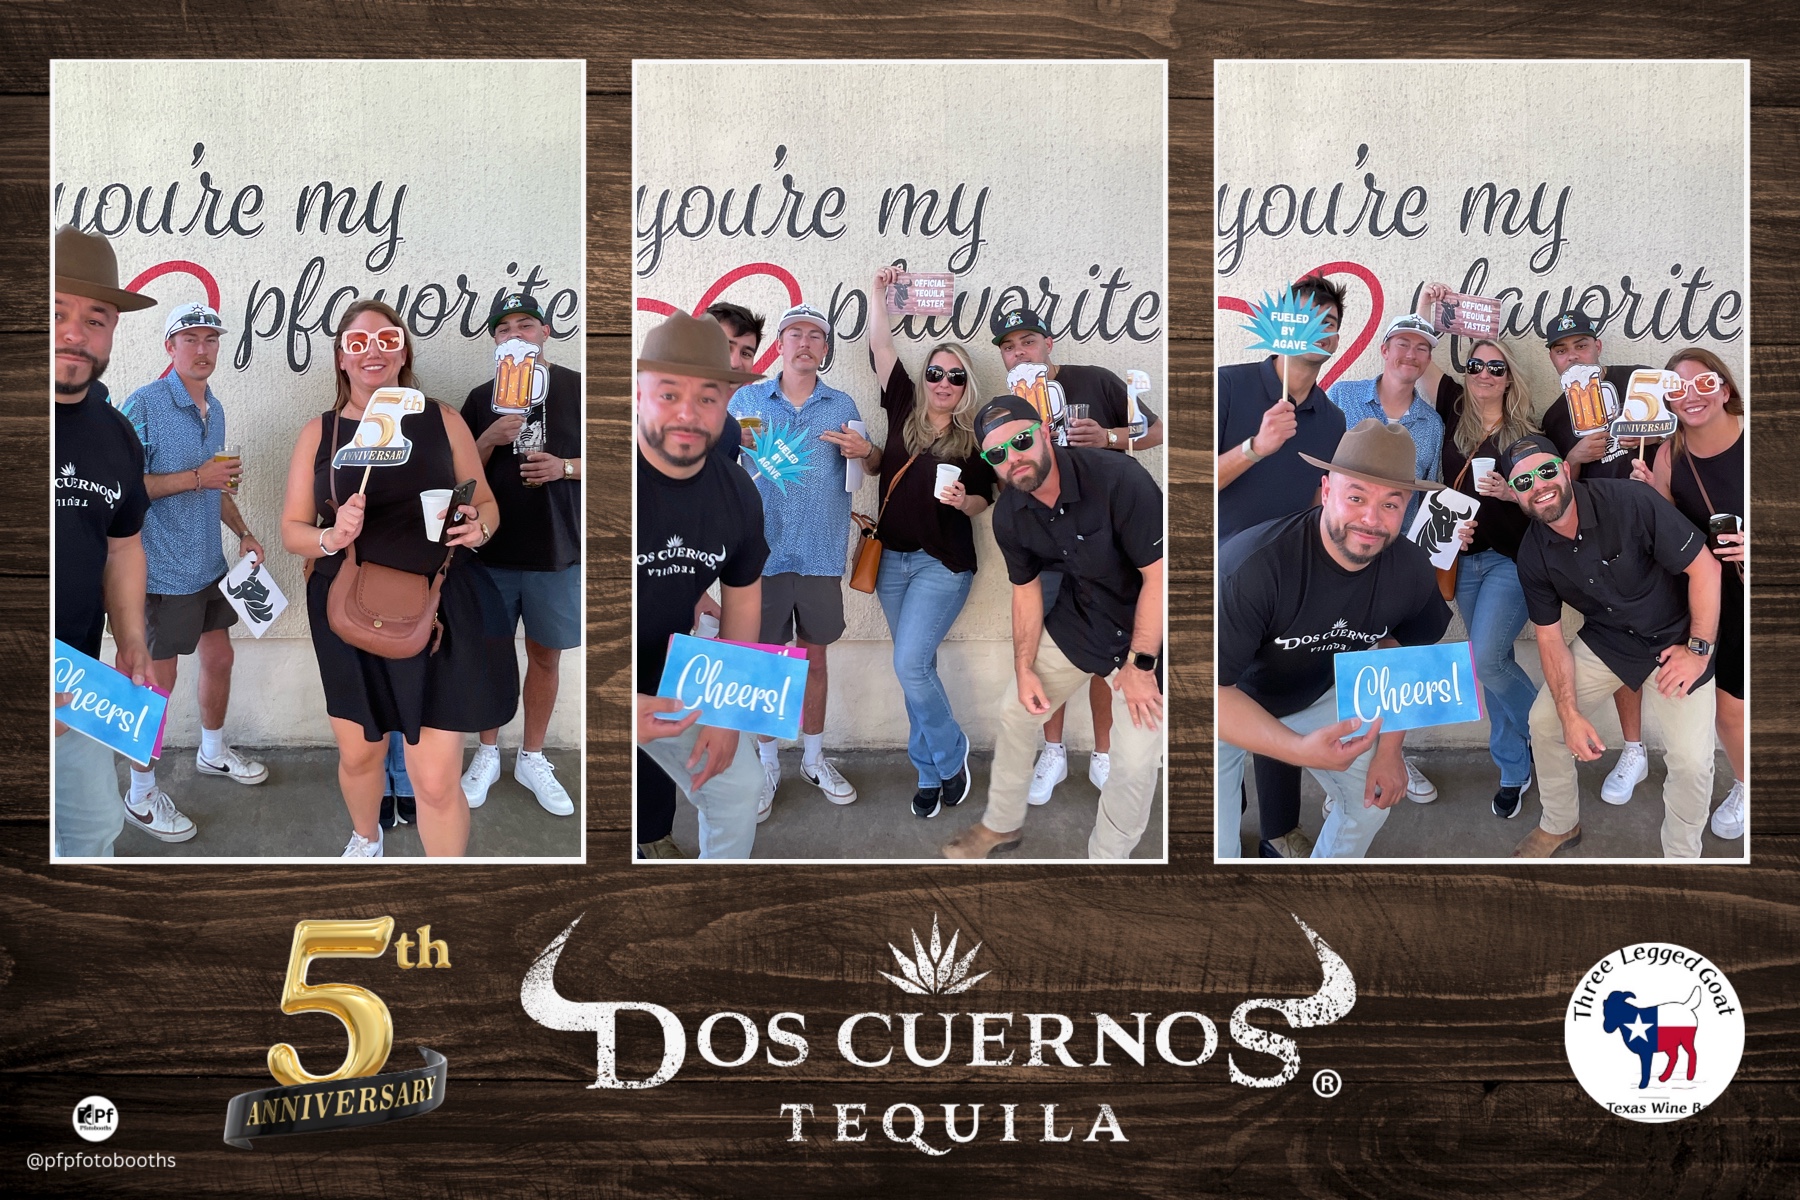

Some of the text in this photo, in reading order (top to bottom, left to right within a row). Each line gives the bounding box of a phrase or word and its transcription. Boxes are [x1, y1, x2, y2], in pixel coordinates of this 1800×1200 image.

[637, 144, 991, 278] you're my
[1218, 143, 1573, 277] you're my
[296, 180, 409, 275] my
[914, 279, 946, 288] OFFICIAL
[915, 289, 945, 298] TEQUILA
[917, 299, 945, 308] TASTER
[1461, 300, 1493, 313] OFFICIAL
[818, 258, 1162, 374] pvorite
[1270, 311, 1310, 325] FUELED
[1410, 257, 1744, 373] favorite
[1461, 311, 1492, 323] TEQUILA
[1281, 327, 1295, 337] BY
[1463, 321, 1491, 333] TASTER
[1272, 339, 1308, 351] AGAVE
[1624, 372, 1680, 421] 5th
[354, 388, 423, 449] 5th
[1616, 421, 1674, 433] ANNIVERSARY
[340, 449, 407, 461] ANNIVERSARY
[771, 453, 784, 464] BY
[774, 439, 799, 464] FUELED
[758, 457, 782, 480] AGAVE
[55, 477, 121, 504] CUERNOS
[637, 552, 655, 566] OS
[1274, 634, 1320, 650] DOS
[1310, 642, 1352, 653] EQUILA
[676, 653, 790, 722] Cheers!
[1353, 661, 1462, 724] Cheers!
